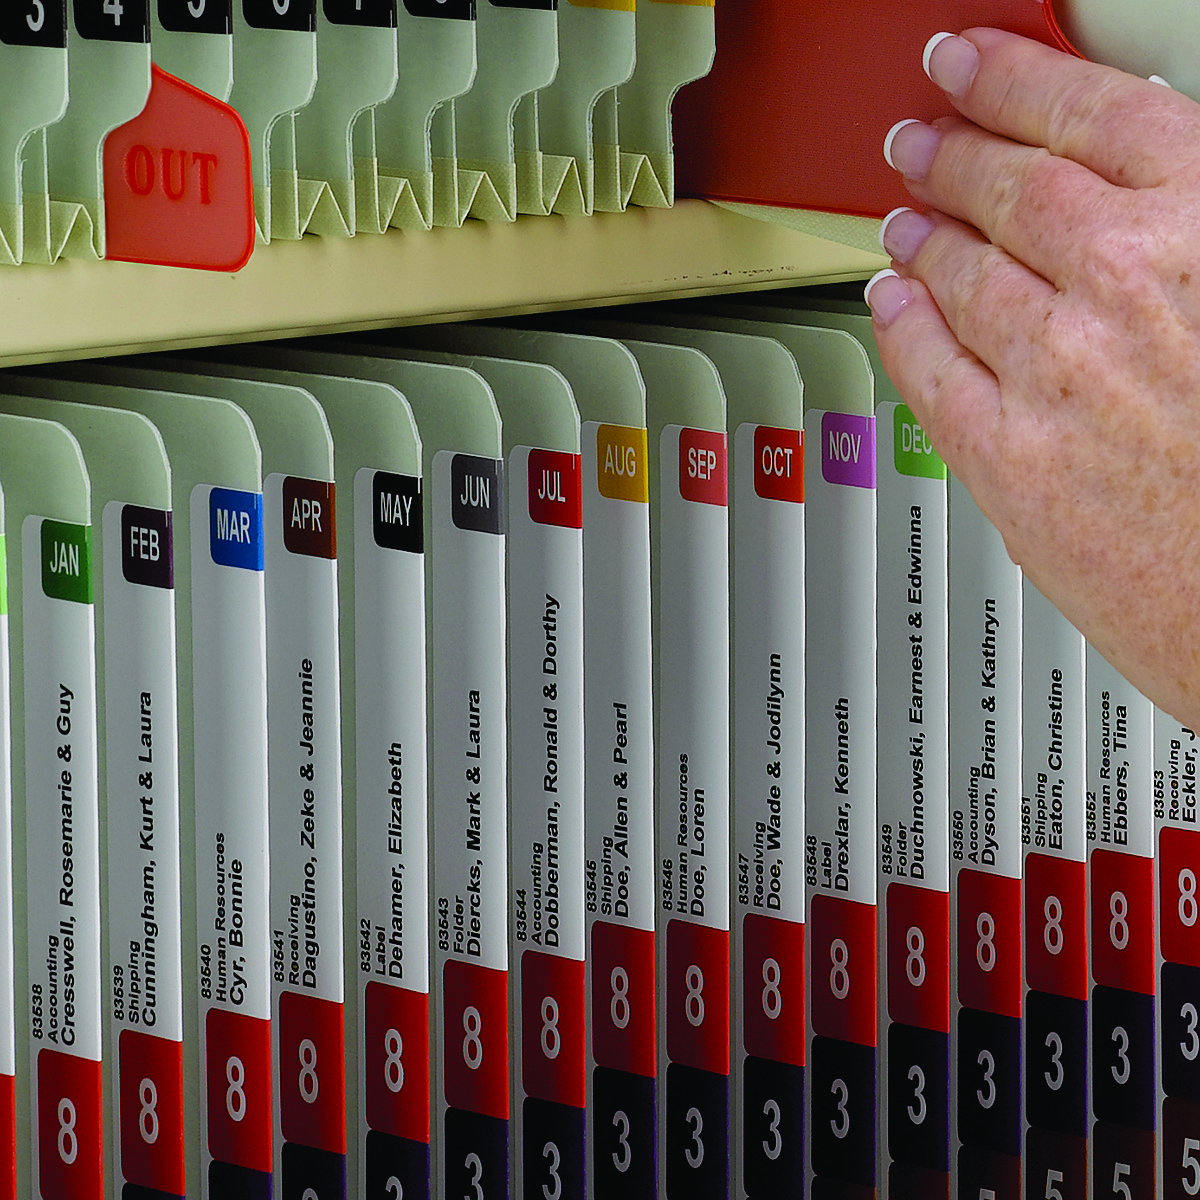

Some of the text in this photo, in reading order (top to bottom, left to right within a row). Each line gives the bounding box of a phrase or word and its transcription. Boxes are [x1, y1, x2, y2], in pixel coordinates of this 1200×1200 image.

[126, 144, 217, 205] OUT
[830, 431, 861, 463] NOV
[292, 498, 321, 532] APR
[381, 492, 412, 526] MAY
[538, 470, 565, 502] JUL
[131, 526, 159, 561] FEB
[217, 509, 250, 543] MAR
[50, 542, 79, 576] JAN
[908, 506, 925, 879] Duchnowski, Earnest & Edwinna
[1048, 669, 1064, 850] Eaton, Christine
[1113, 706, 1129, 845] Ebbers, Tina
[466, 690, 483, 956] Diercks, Mark & Laura
[691, 789, 707, 916] Doe, Loren
[57, 684, 76, 1046] Cresswell, Rosemarie & Guy
[138, 692, 158, 1026] Cunningham, Kurt & Laura
[388, 743, 404, 979] Dehamer, Elizabeth
[516, 889, 527, 941] 83544
[1178, 868, 1198, 927] 8
[228, 859, 247, 1005] Cyr, Bonnie
[47, 935, 59, 1044] Accounting
[201, 945, 211, 999] 83540
[32, 984, 43, 1039] 83538
